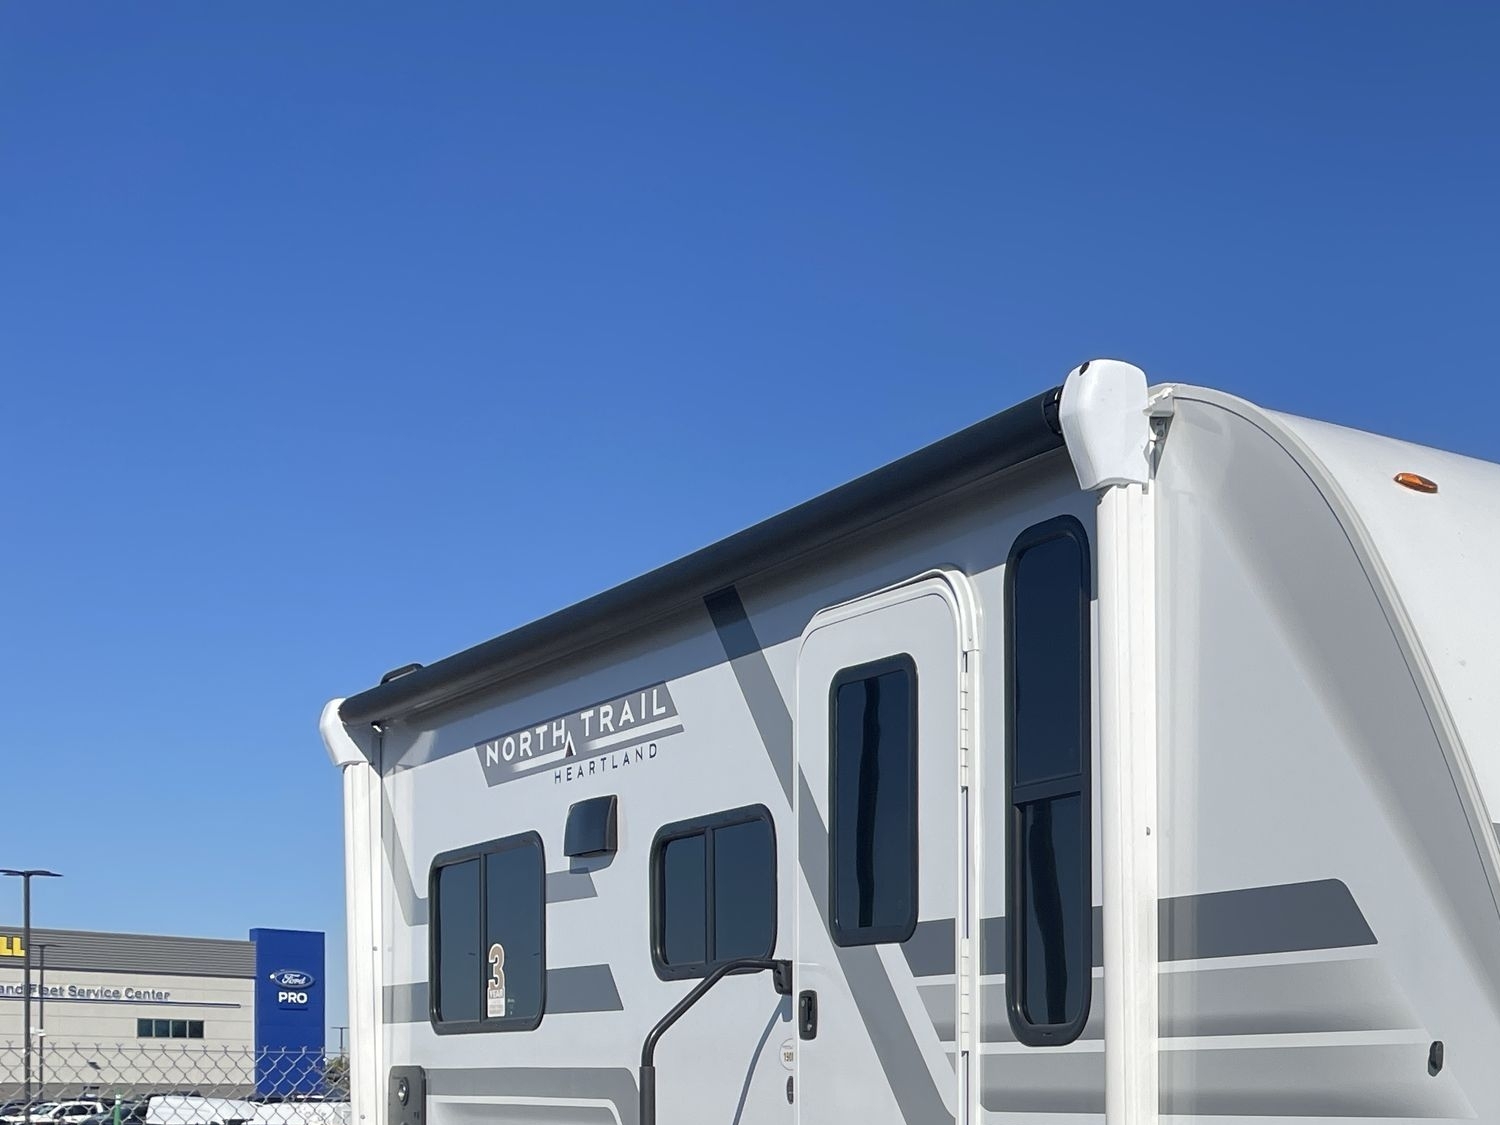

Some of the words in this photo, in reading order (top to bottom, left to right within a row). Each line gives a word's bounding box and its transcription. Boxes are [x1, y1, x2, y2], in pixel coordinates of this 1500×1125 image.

[486, 719, 566, 767] NORTH
[580, 689, 666, 737] TRAIL
[554, 743, 658, 784] HEARTLAND
[282, 974, 306, 985] Ford
[489, 943, 505, 989] 3
[0, 983, 24, 995] and
[68, 985, 121, 999] Service
[124, 987, 170, 1000] Center
[279, 991, 308, 1003] PRO
